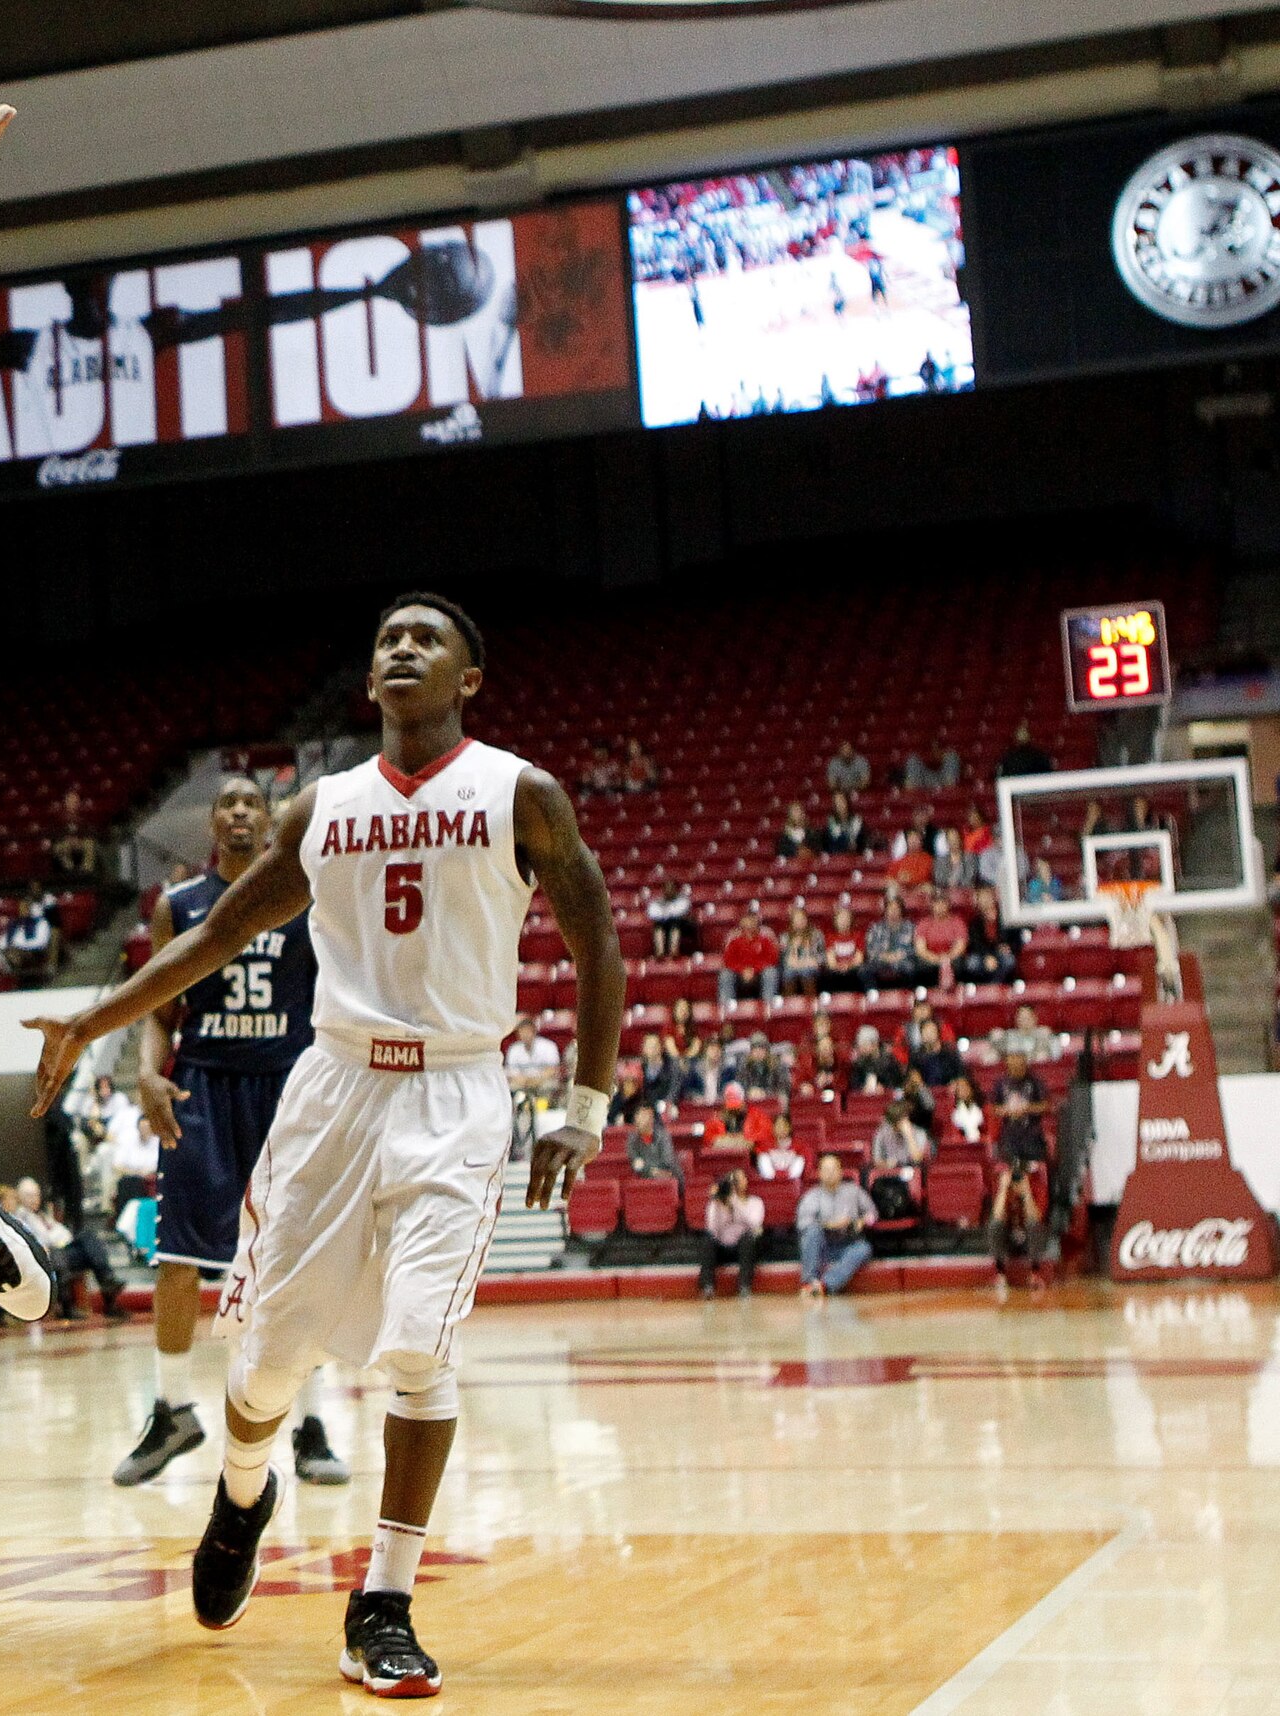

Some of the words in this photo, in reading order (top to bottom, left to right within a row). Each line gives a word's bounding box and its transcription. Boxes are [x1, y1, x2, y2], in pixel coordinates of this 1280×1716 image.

[1087, 643, 1151, 698] 23
[321, 809, 491, 857] ALABAMA
[384, 862, 425, 936] 5
[222, 961, 273, 1011] 35
[371, 1040, 422, 1068] BAMA
